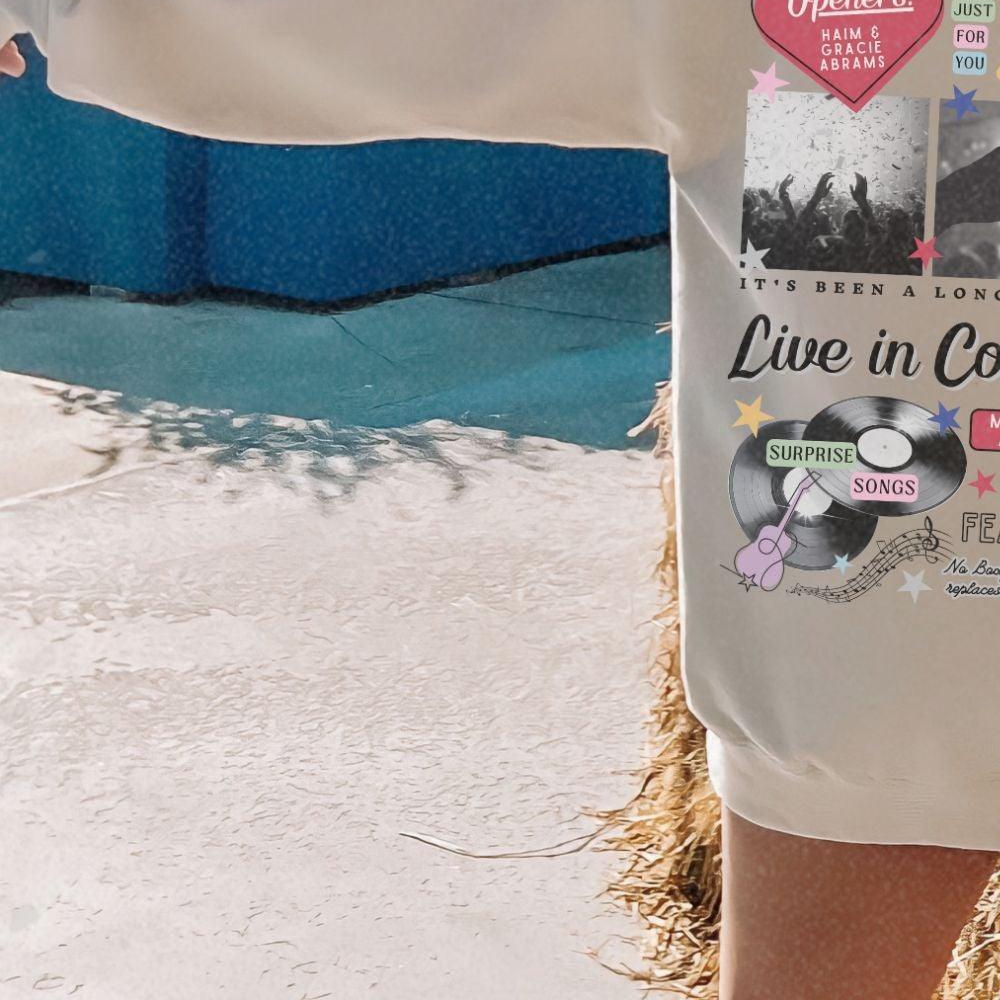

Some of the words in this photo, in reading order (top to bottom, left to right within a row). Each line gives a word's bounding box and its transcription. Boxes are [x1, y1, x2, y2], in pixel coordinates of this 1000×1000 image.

[953, 3, 994, 18] JUST
[821, 26, 862, 41] HAIM
[870, 25, 881, 40] &
[956, 29, 986, 45] FOR
[821, 40, 883, 56] GRACIE
[820, 55, 886, 72] ABRAMS
[955, 55, 985, 71] YOU
[740, 277, 797, 292] IT'S
[816, 281, 884, 296] BEEN
[903, 285, 916, 297] A
[728, 314, 853, 380] Live
[868, 328, 921, 378] in
[769, 444, 854, 464] SURPRISE
[853, 477, 916, 496] SONGS
[944, 558, 968, 575] No
